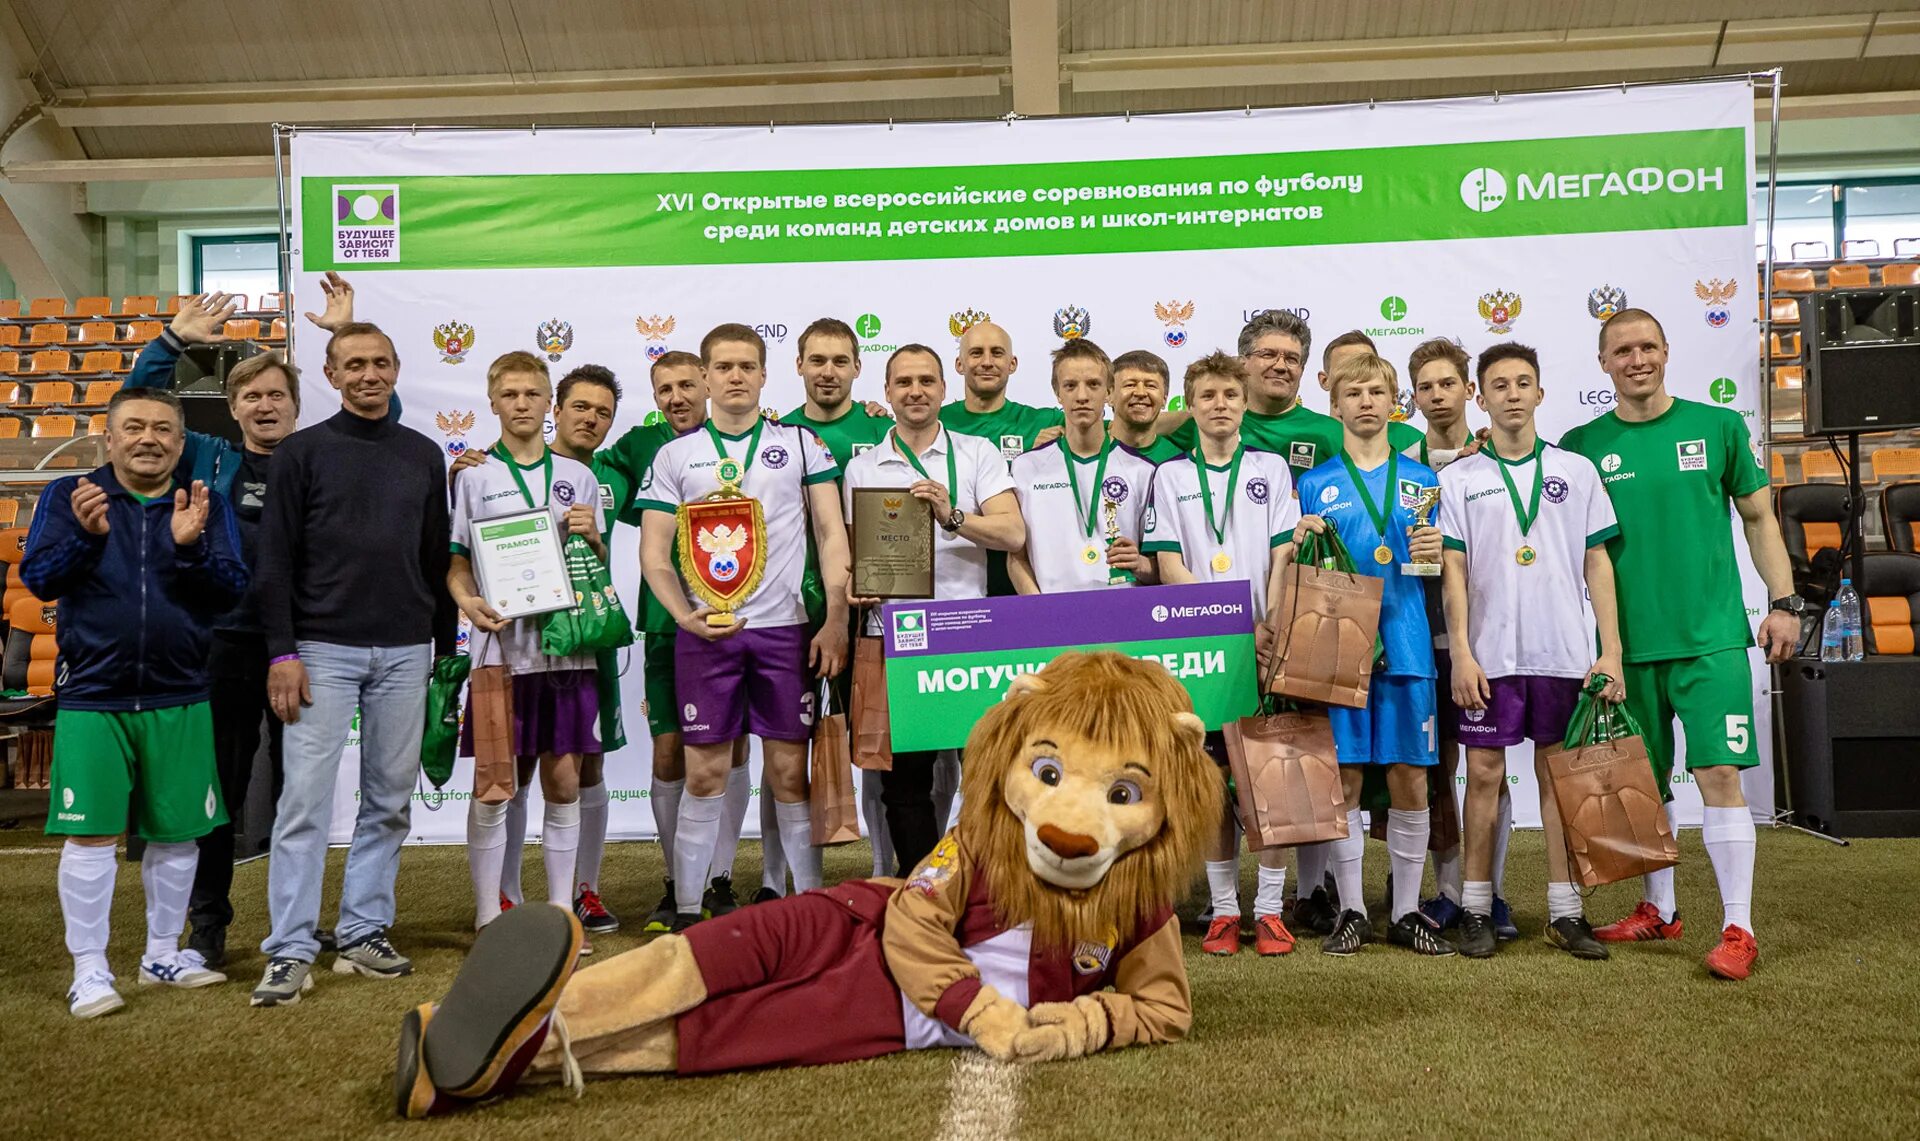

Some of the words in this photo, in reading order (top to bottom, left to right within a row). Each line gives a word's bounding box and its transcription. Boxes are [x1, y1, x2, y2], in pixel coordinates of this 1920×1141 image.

[655, 193, 694, 212] XVI
[702, 191, 828, 214] Открытые
[834, 185, 1027, 211] всероссийские
[1033, 180, 1213, 205] соревнования
[1219, 180, 1249, 195] по
[1255, 172, 1363, 197] футболу
[338, 230, 395, 240] БУДУЩЕЕ
[704, 223, 780, 243] среди
[787, 221, 882, 237] команд
[887, 218, 988, 236] детских
[993, 214, 1075, 234] домов
[1081, 215, 1096, 229] и
[1102, 205, 1323, 228] школ-интернатов
[339, 240, 394, 249] ЗАВИСИТ
[344, 250, 359, 258] ОТ
[362, 249, 389, 258] ТЕБЯ
[1422, 715, 1436, 752] 1
[1725, 714, 1749, 754] 5
